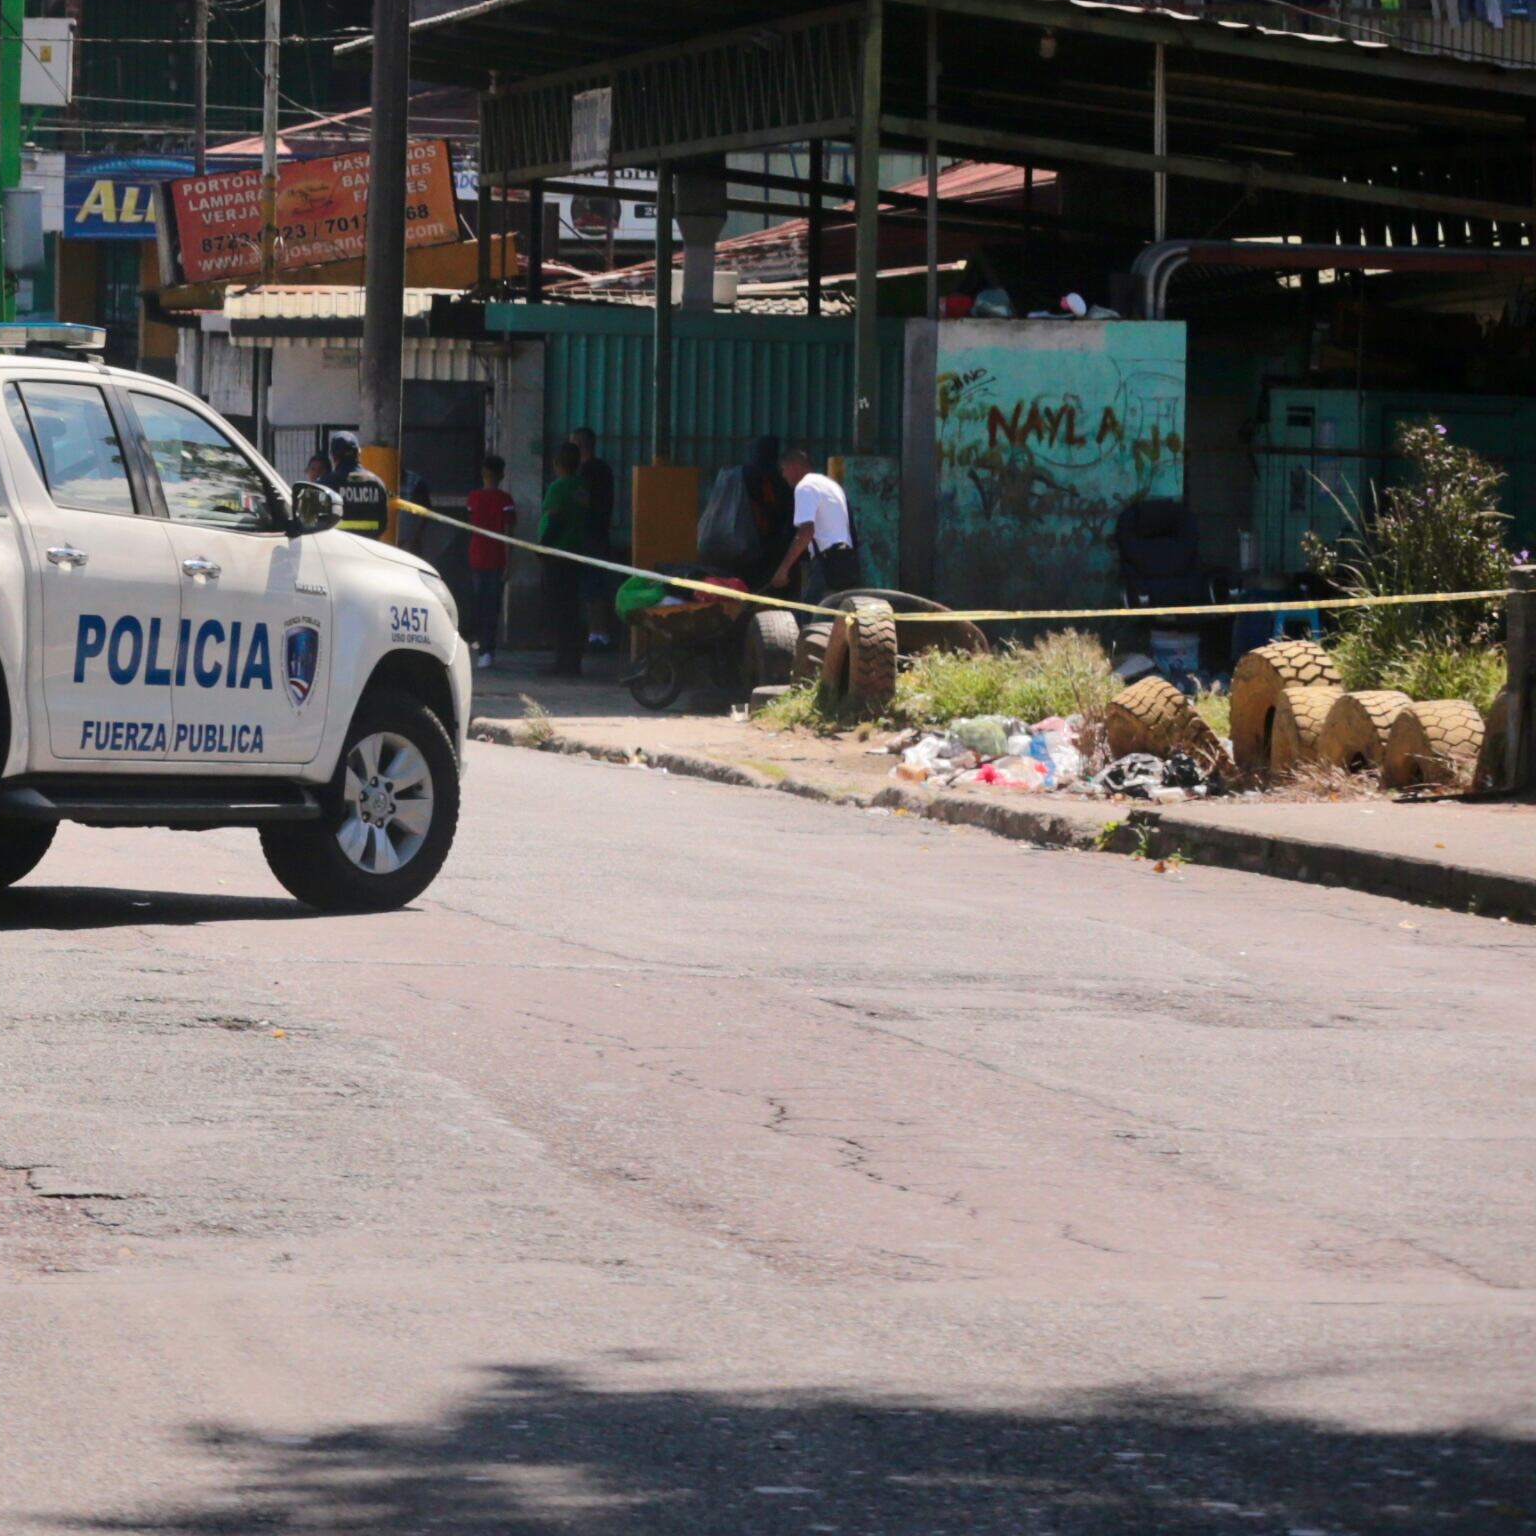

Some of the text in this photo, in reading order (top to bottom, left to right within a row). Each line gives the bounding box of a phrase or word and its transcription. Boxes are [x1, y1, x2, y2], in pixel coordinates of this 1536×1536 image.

[74, 179, 157, 223] AL
[188, 187, 279, 212] LAMPARA
[340, 486, 380, 503] POLICIA
[389, 605, 429, 633] 3457
[73, 613, 274, 690] POLICIA
[80, 720, 265, 754] FUERZA PUBLICA
